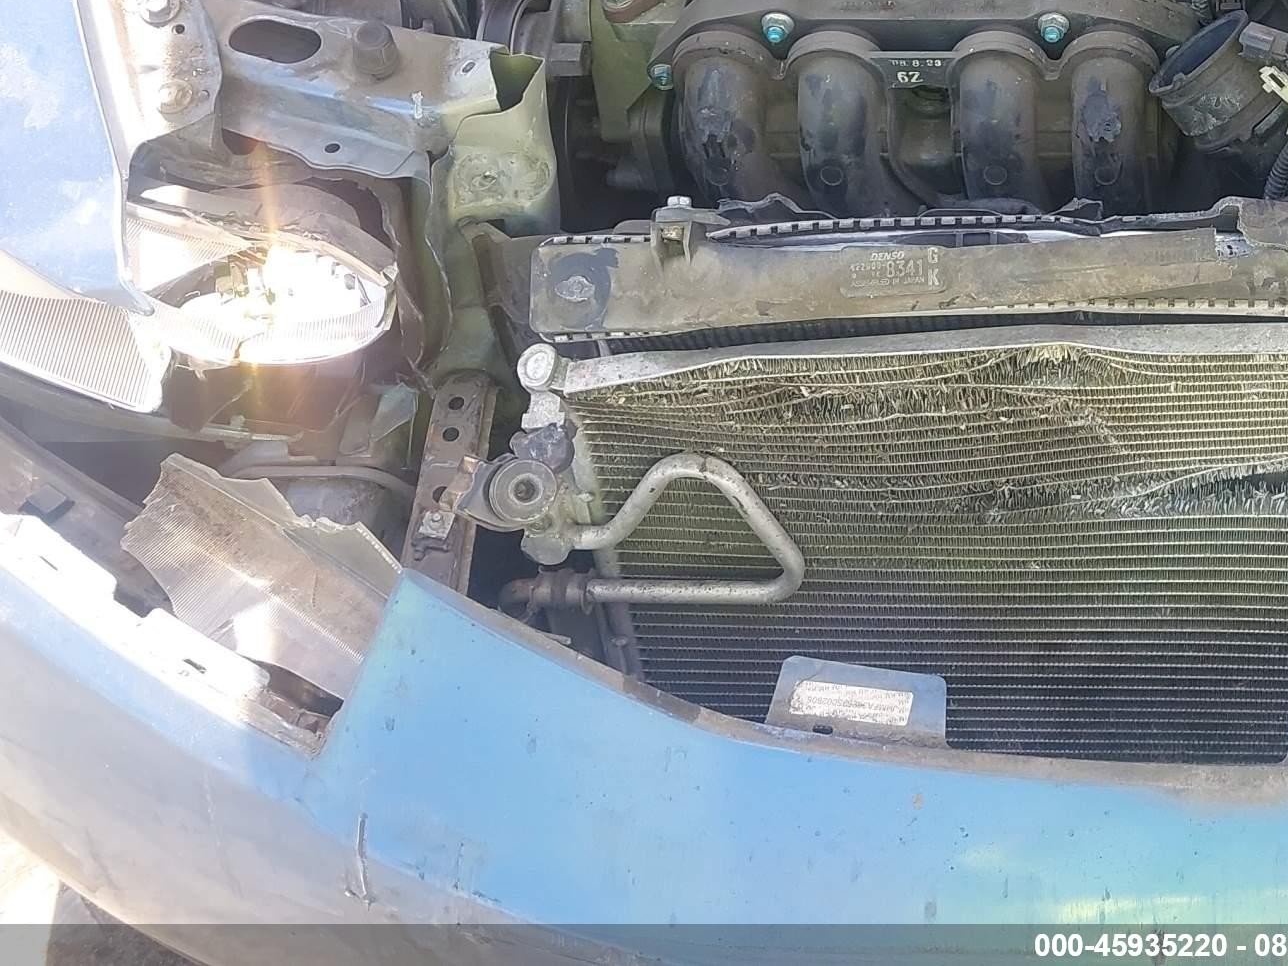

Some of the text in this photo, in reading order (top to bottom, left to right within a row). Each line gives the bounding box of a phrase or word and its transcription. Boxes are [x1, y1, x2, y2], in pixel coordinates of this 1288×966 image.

[871, 250, 904, 261] DENSO
[927, 247, 938, 264] G
[927, 267, 940, 287] K
